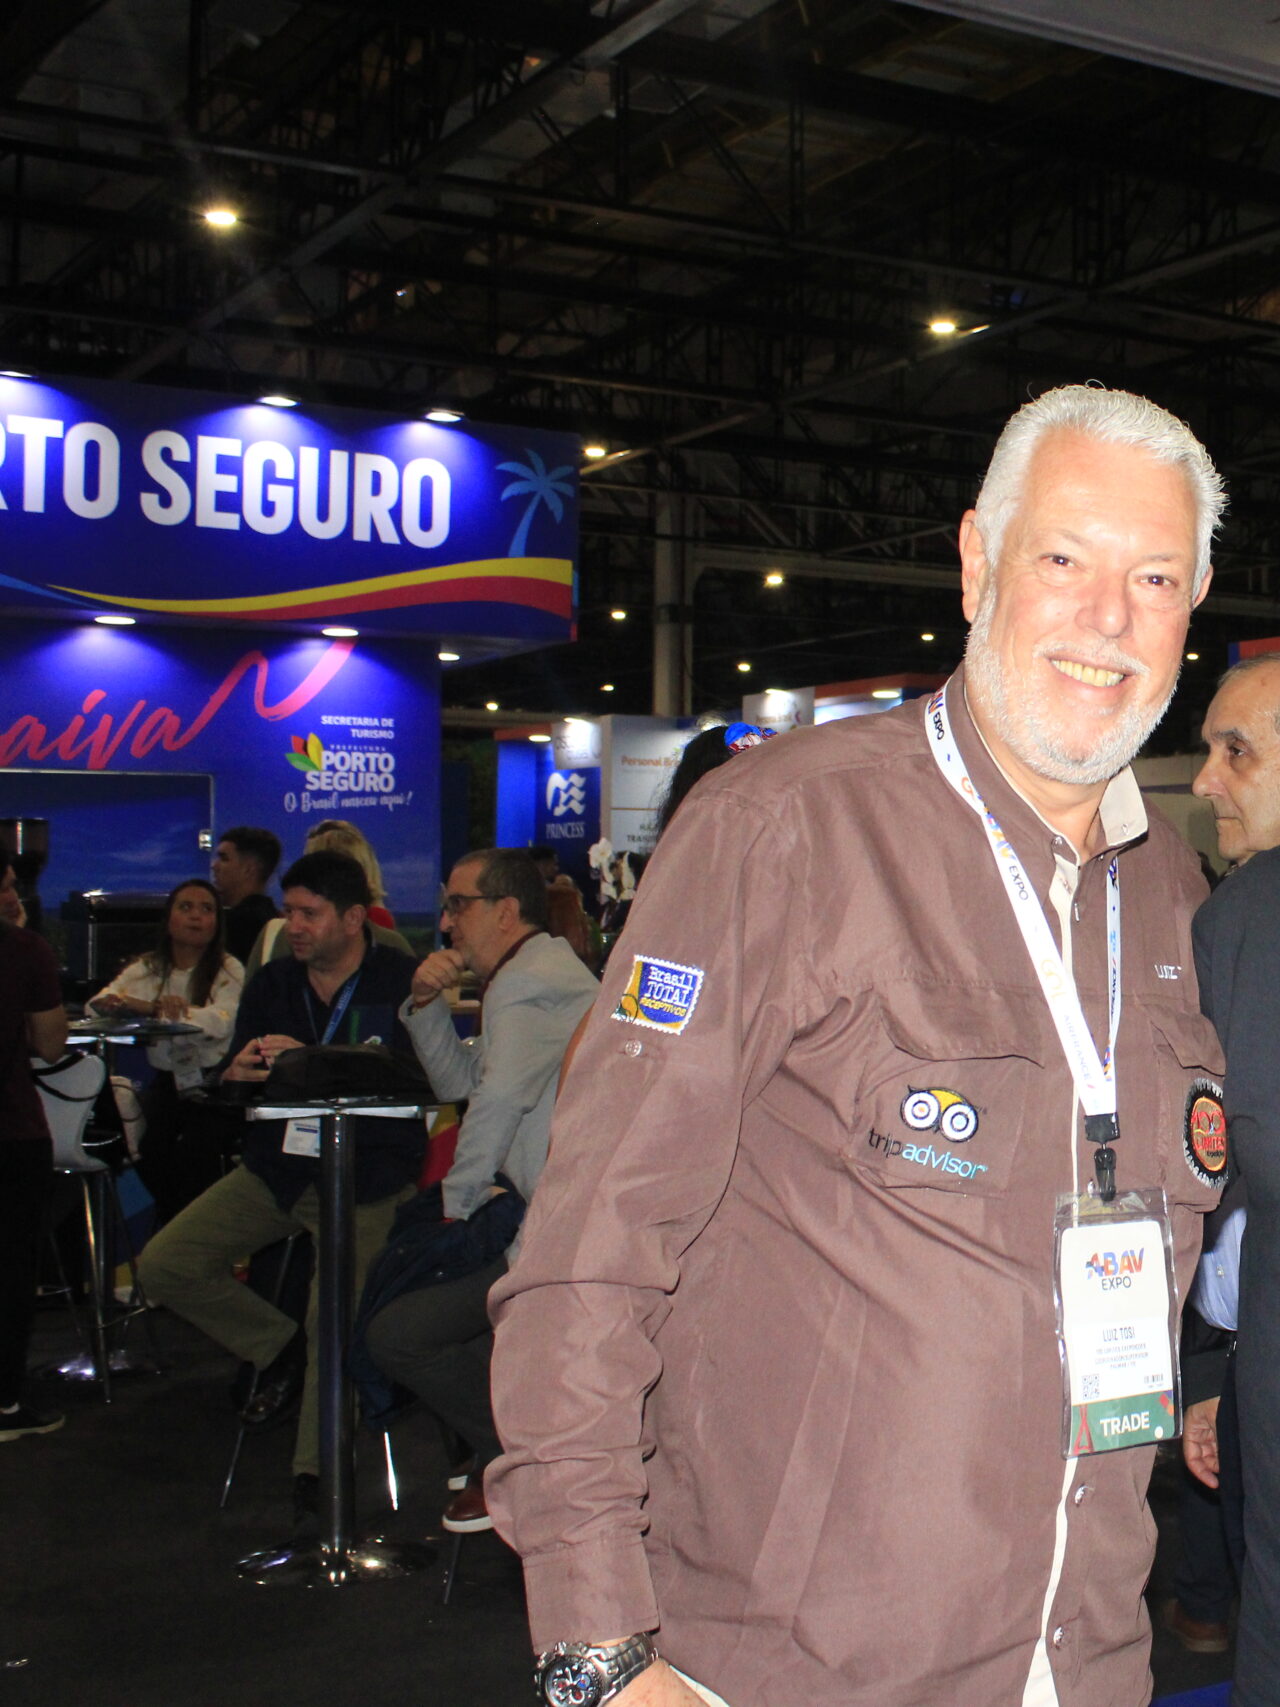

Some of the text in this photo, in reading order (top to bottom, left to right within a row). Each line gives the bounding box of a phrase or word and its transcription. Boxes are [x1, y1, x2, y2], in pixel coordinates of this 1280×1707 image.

[0, 414, 452, 549] TO SEGURO
[321, 715, 395, 728] SECRETARIA DE
[350, 728, 395, 739] TURISMO
[932, 711, 946, 741] EXPO
[321, 750, 396, 773] PORTO
[305, 770, 396, 793] SEGURO
[545, 822, 586, 840] PRINCESS
[1008, 864, 1030, 902] EXPO
[648, 965, 694, 990] Brasil
[643, 980, 691, 1008] TOTAL
[868, 1127, 989, 1179] tripadvisor
[1085, 1247, 1145, 1280] ABAV
[1101, 1275, 1132, 1291] EXPO
[1102, 1327, 1119, 1343] LUIZ
[1099, 1411, 1151, 1437] TRADE
